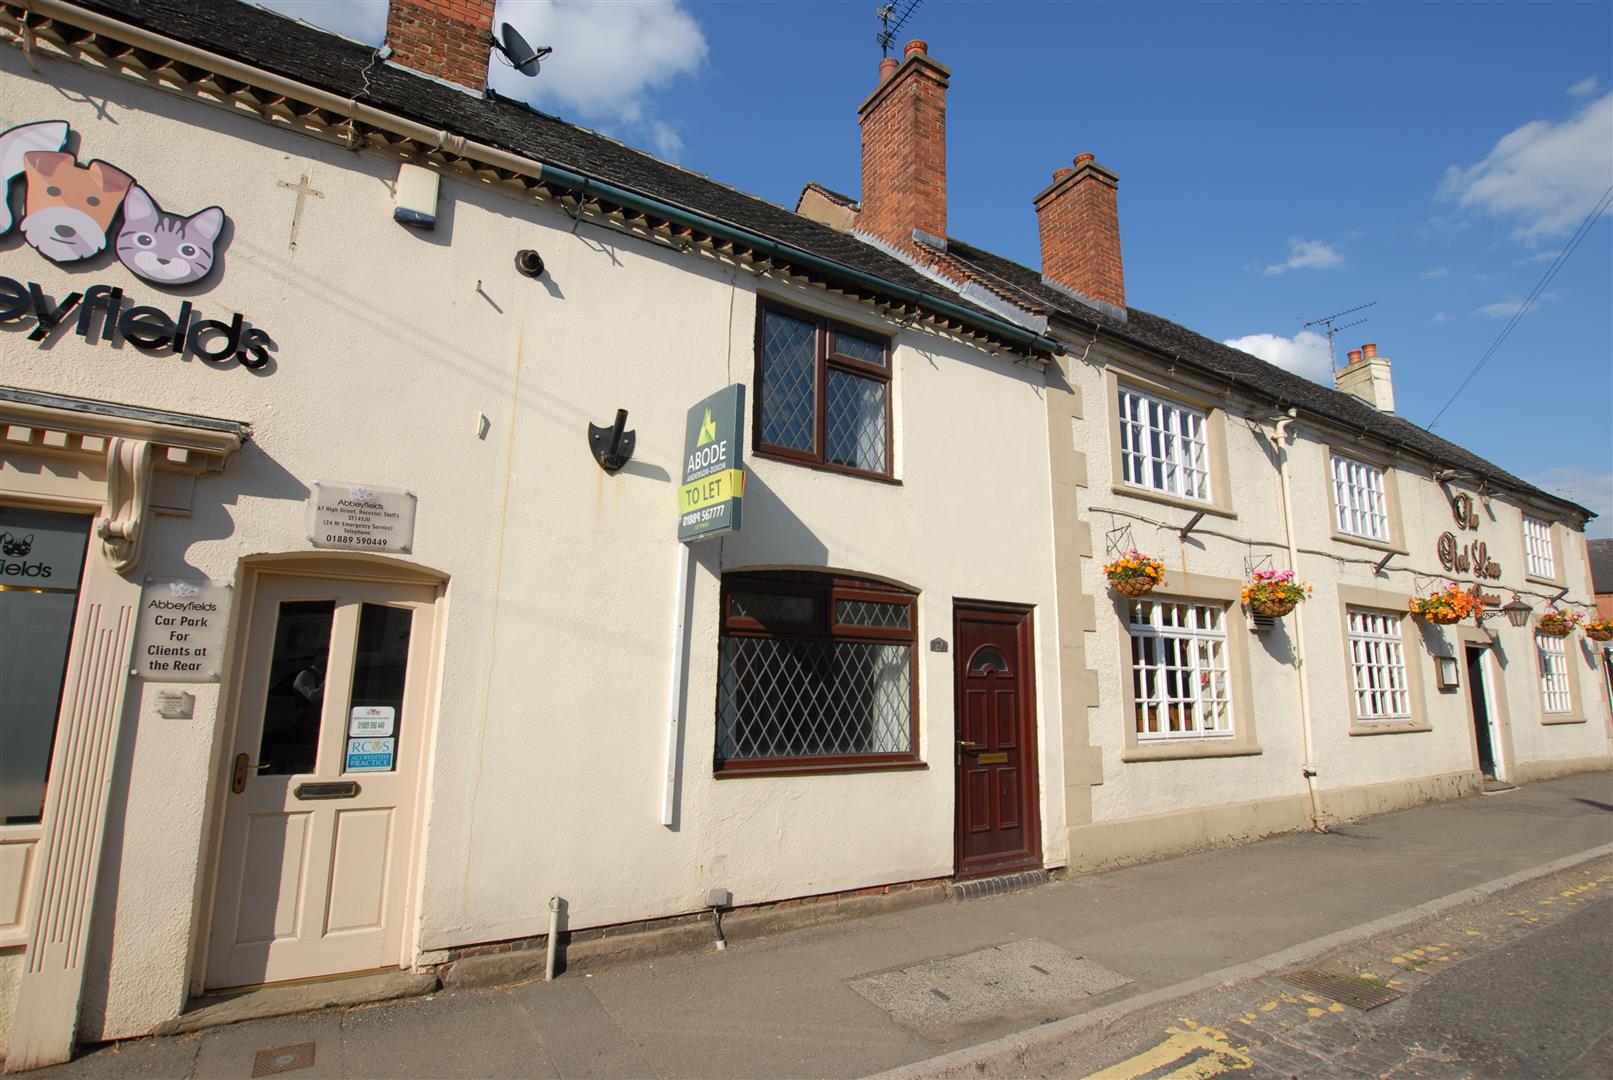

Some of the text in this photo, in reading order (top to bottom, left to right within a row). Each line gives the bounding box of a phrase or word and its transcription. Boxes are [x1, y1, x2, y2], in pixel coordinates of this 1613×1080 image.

[0, 275, 271, 369] eyfields
[687, 440, 727, 473] ABODE
[685, 479, 722, 506] TO LET
[337, 499, 384, 510] Abbeyfields
[682, 511, 701, 527] 01889
[701, 504, 725, 522] 567777
[341, 521, 371, 530] Emergency
[326, 534, 388, 546] 01889 590449
[0, 560, 52, 578] ields
[148, 600, 217, 612] Abbeyfields
[154, 615, 208, 627] Car Park
[169, 630, 190, 641] For
[147, 645, 207, 656] Clients at
[149, 660, 202, 671] the Rear
[351, 759, 387, 767] PRACTICE
